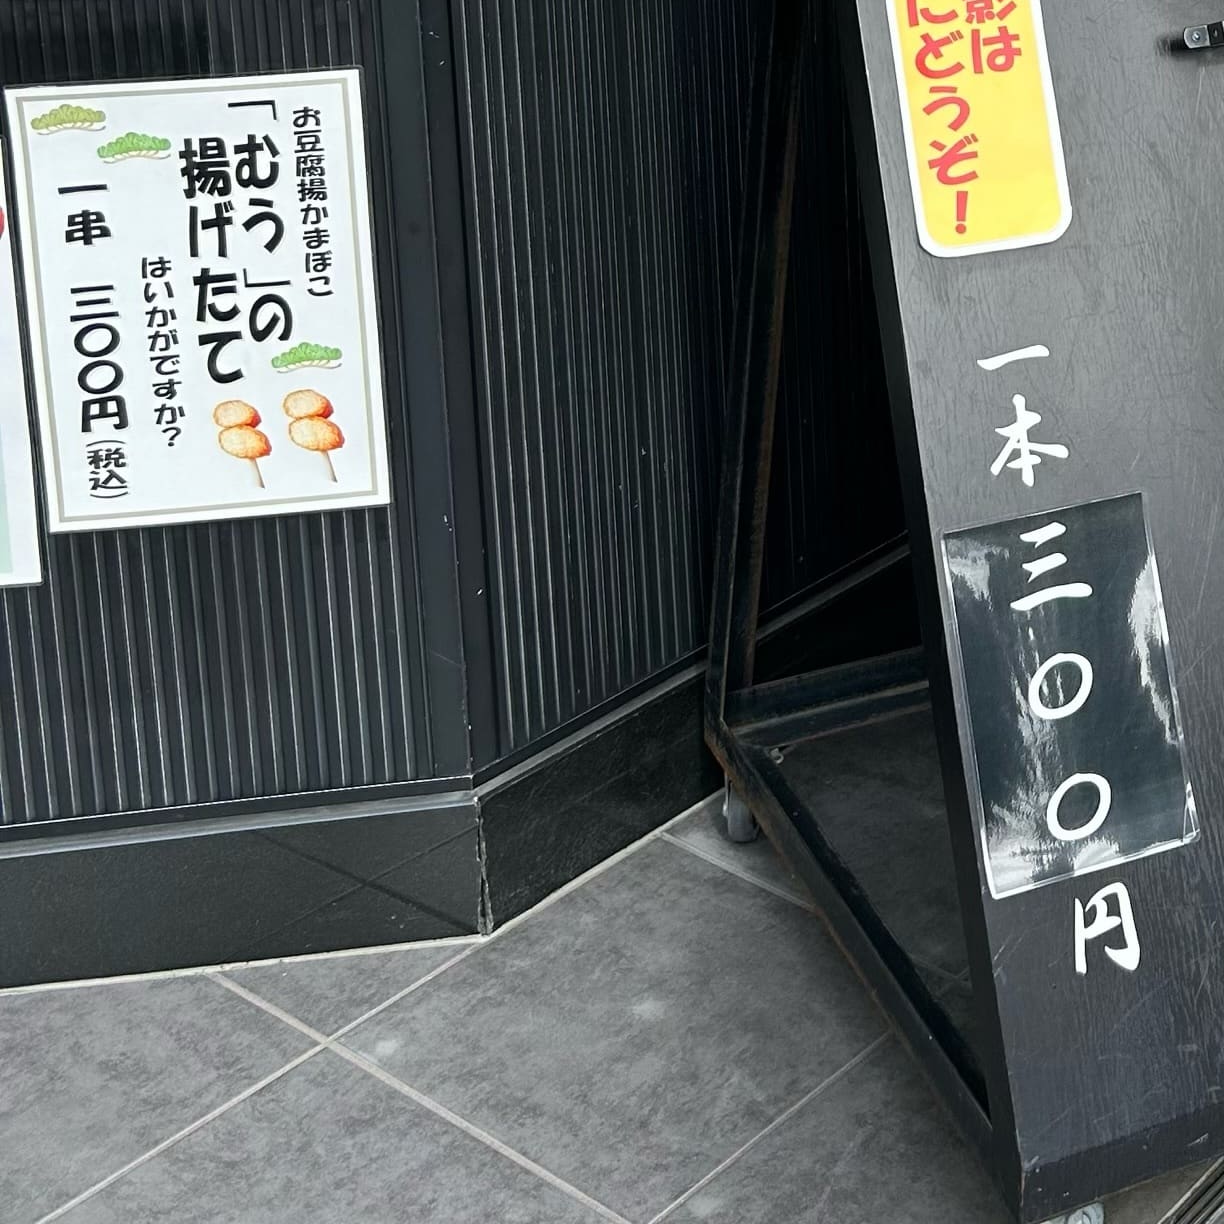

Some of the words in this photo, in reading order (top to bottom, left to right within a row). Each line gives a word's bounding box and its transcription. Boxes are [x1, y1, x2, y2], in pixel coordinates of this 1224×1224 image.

[57, 183, 113, 247] 一串
[179, 136, 245, 385] 揚げたて
[228, 100, 293, 343] 「むう」の
[293, 107, 334, 298] お豆腐揚かまぼこ
[141, 257, 186, 448] はいかがですか?
